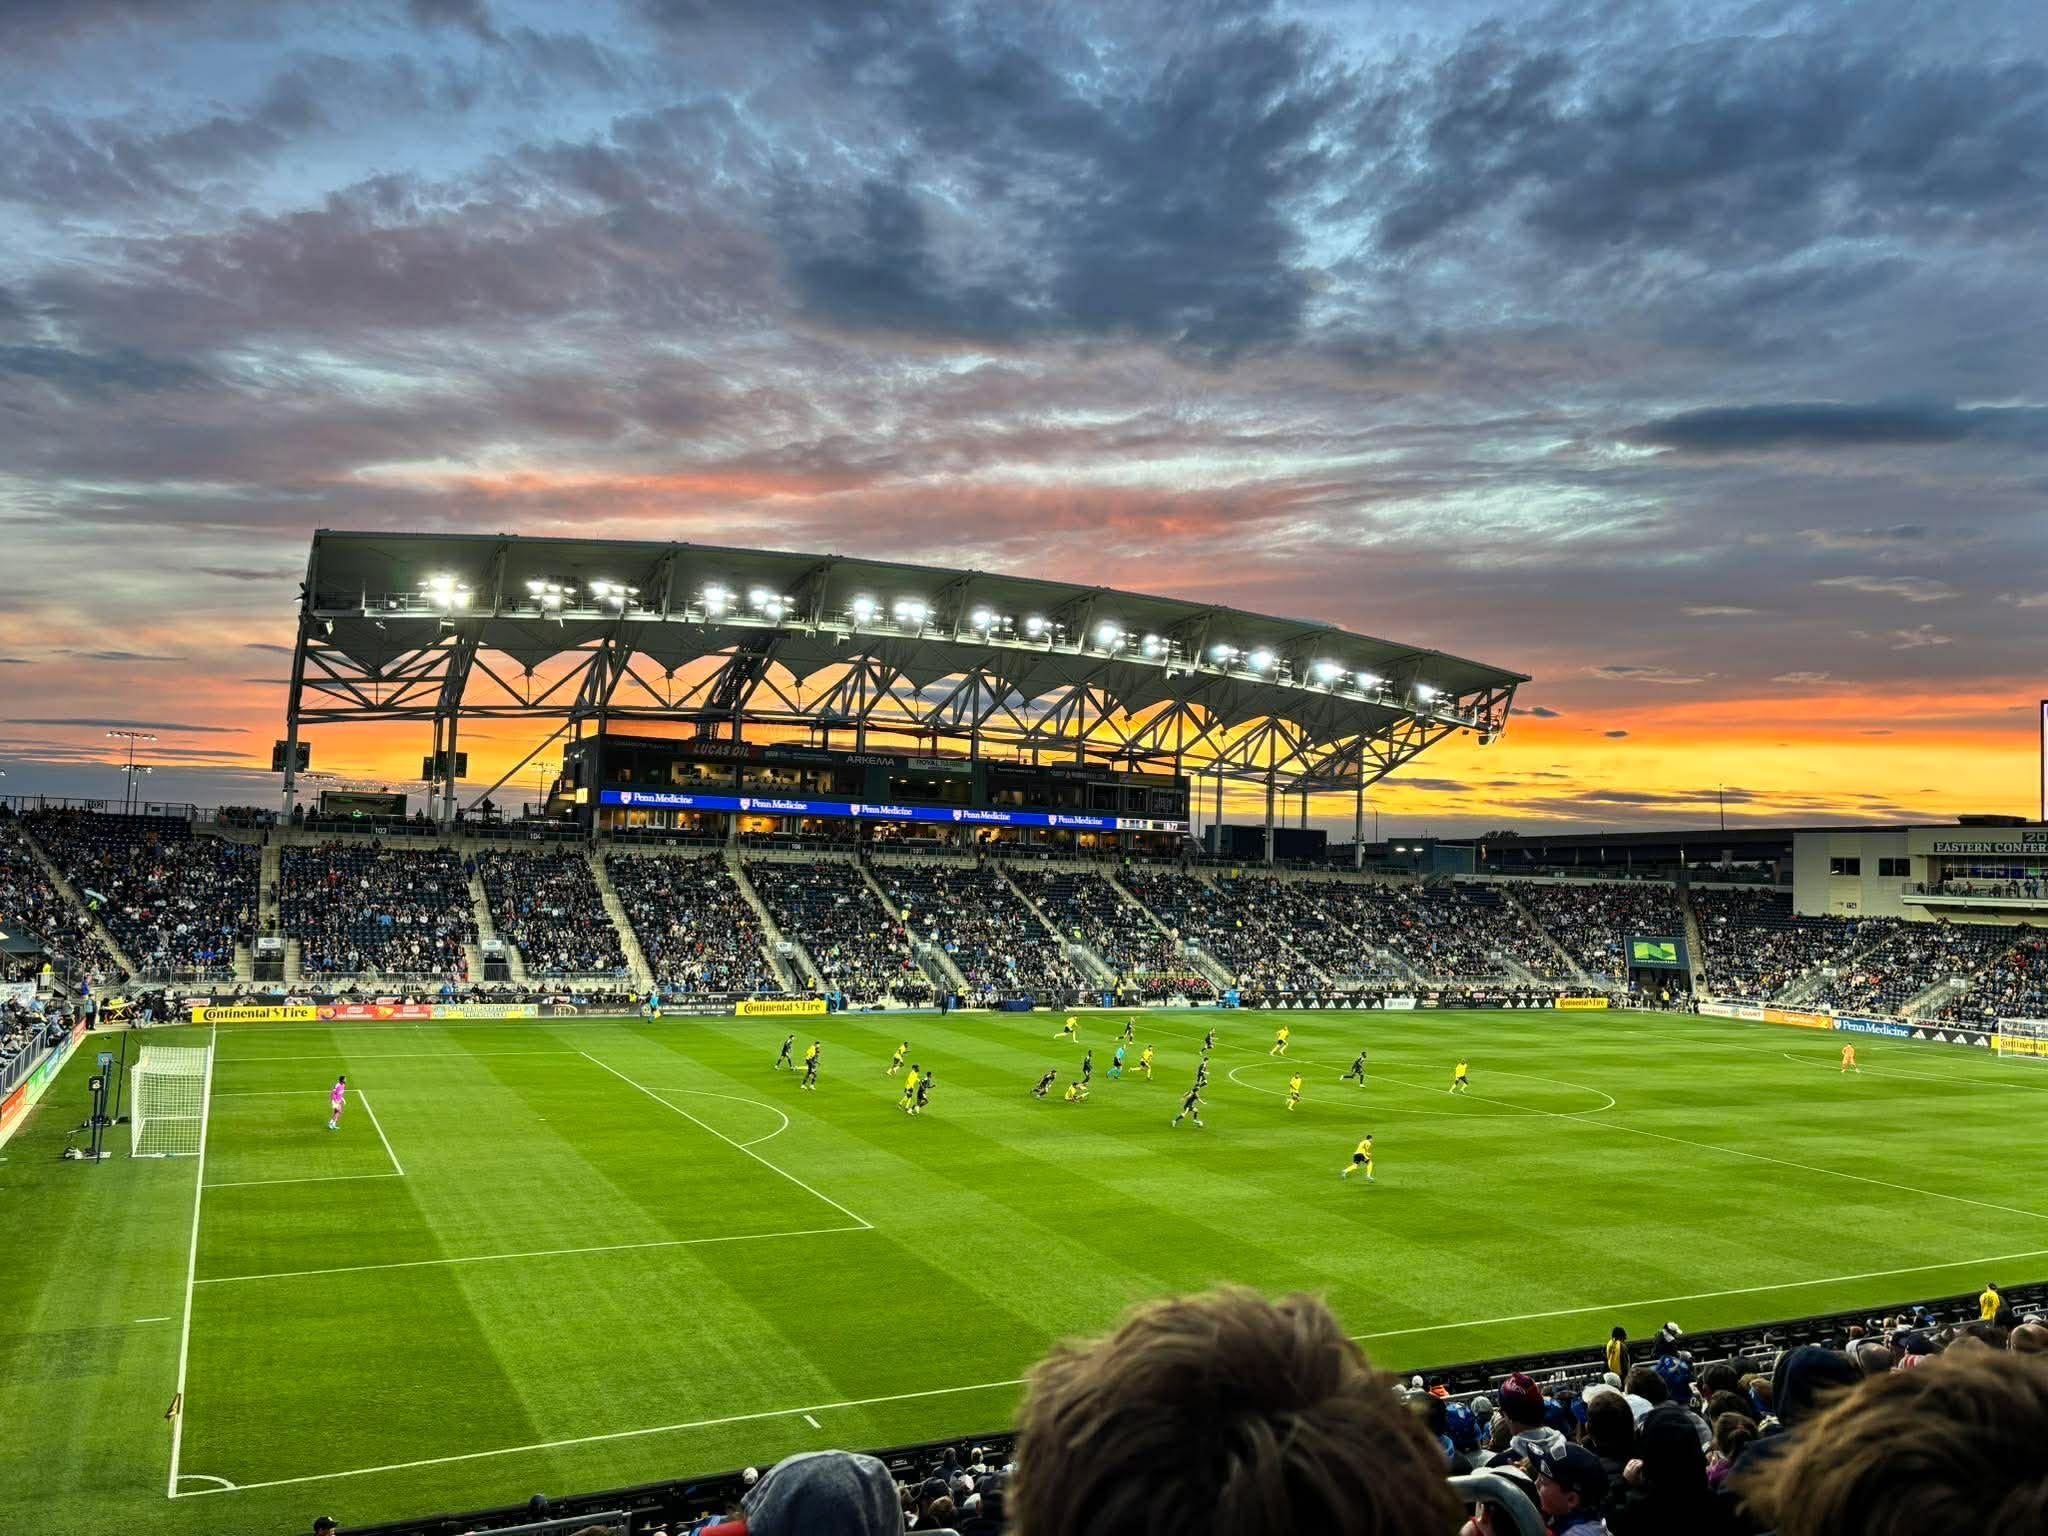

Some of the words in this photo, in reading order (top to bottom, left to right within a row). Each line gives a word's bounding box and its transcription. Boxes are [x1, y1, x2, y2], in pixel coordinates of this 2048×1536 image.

[694, 743, 729, 756] LUCAS
[731, 747, 750, 758] OIL
[846, 755, 895, 766] ARKEMA
[634, 792, 655, 802] Penn
[655, 793, 694, 804] Medicine
[752, 799, 772, 808] Penn
[772, 800, 808, 810] Medicine
[862, 804, 880, 814] Penn
[880, 805, 913, 816] Medicine
[963, 810, 981, 819] Penn
[981, 811, 1011, 821] Medicine
[1073, 816, 1103, 826] Medicine
[1936, 842, 1992, 852] EASTERN
[203, 1007, 270, 1021] Continental
[281, 1007, 308, 1018] Tire
[744, 1003, 793, 1014] Continental
[801, 1003, 820, 1012] Tire
[1842, 1020, 1866, 1032] Penn
[1865, 1023, 1909, 1037] Medicine
